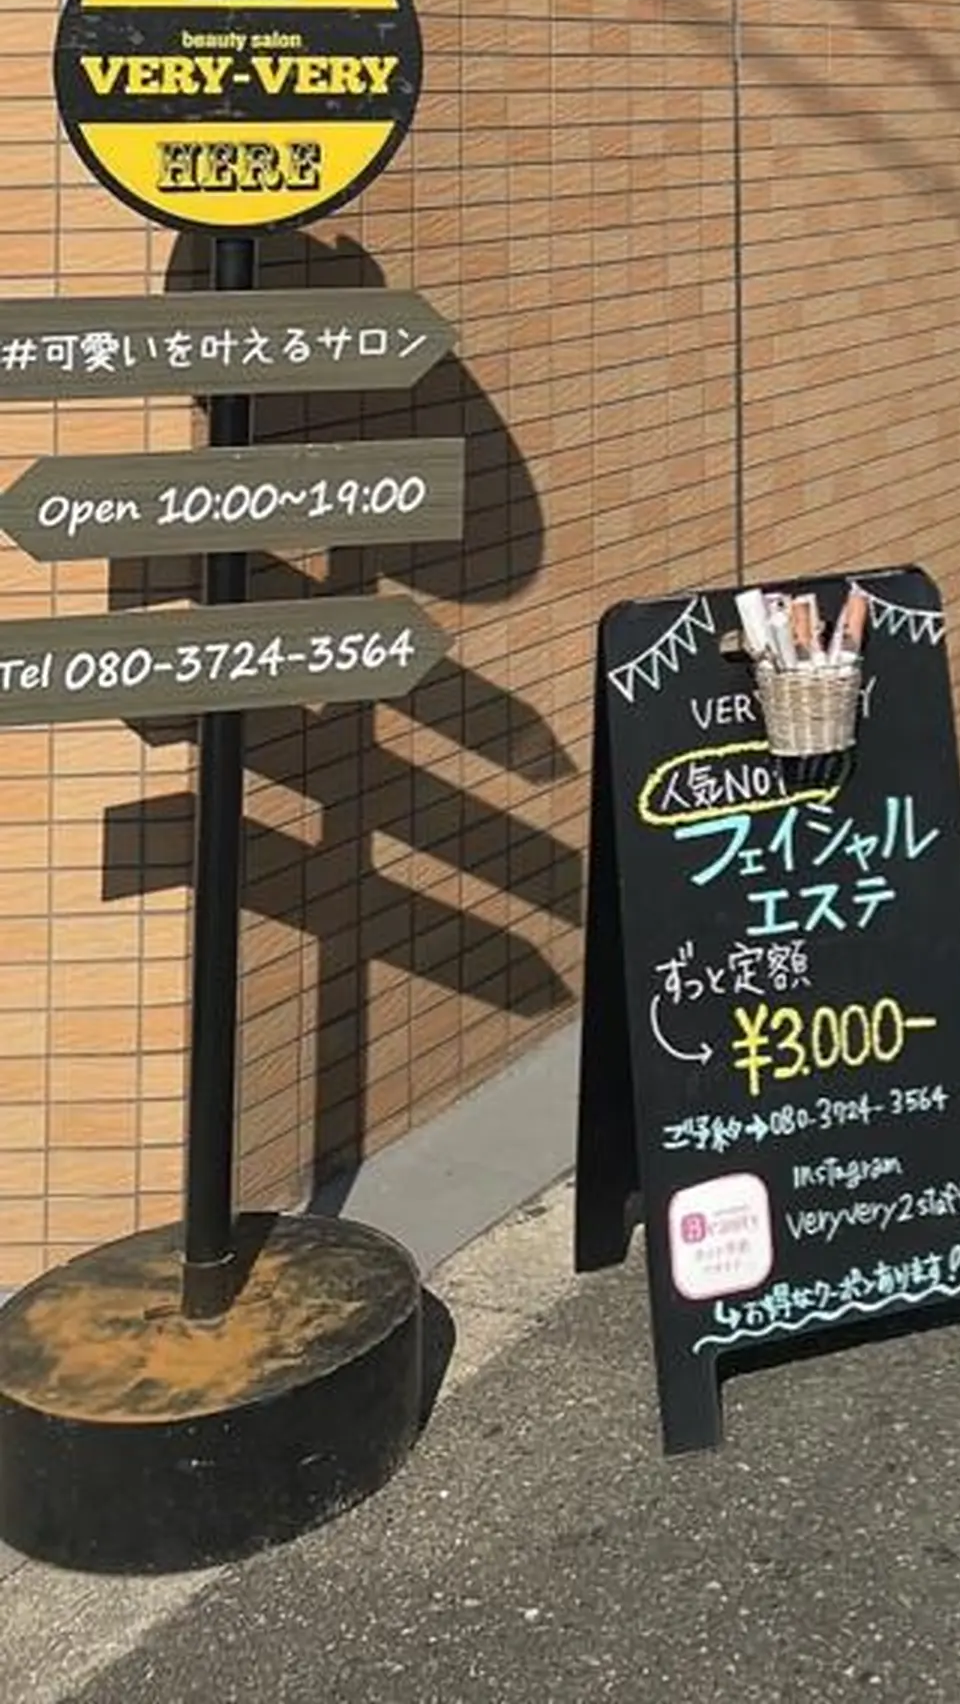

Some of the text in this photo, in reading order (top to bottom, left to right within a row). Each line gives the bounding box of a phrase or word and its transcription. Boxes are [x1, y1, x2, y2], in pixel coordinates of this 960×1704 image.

[182, 29, 303, 51] beauty salon
[79, 55, 399, 96] VERY-VERY
[157, 140, 323, 194] HERE
[2, 326, 428, 373] #可愛いを叶えるサロン
[38, 492, 142, 537] Open
[0, 627, 415, 691] Tel 080-3724-3564
[674, 796, 941, 884] フェイシャル
[746, 875, 897, 936] エステ
[654, 940, 812, 1003] ずっと定額
